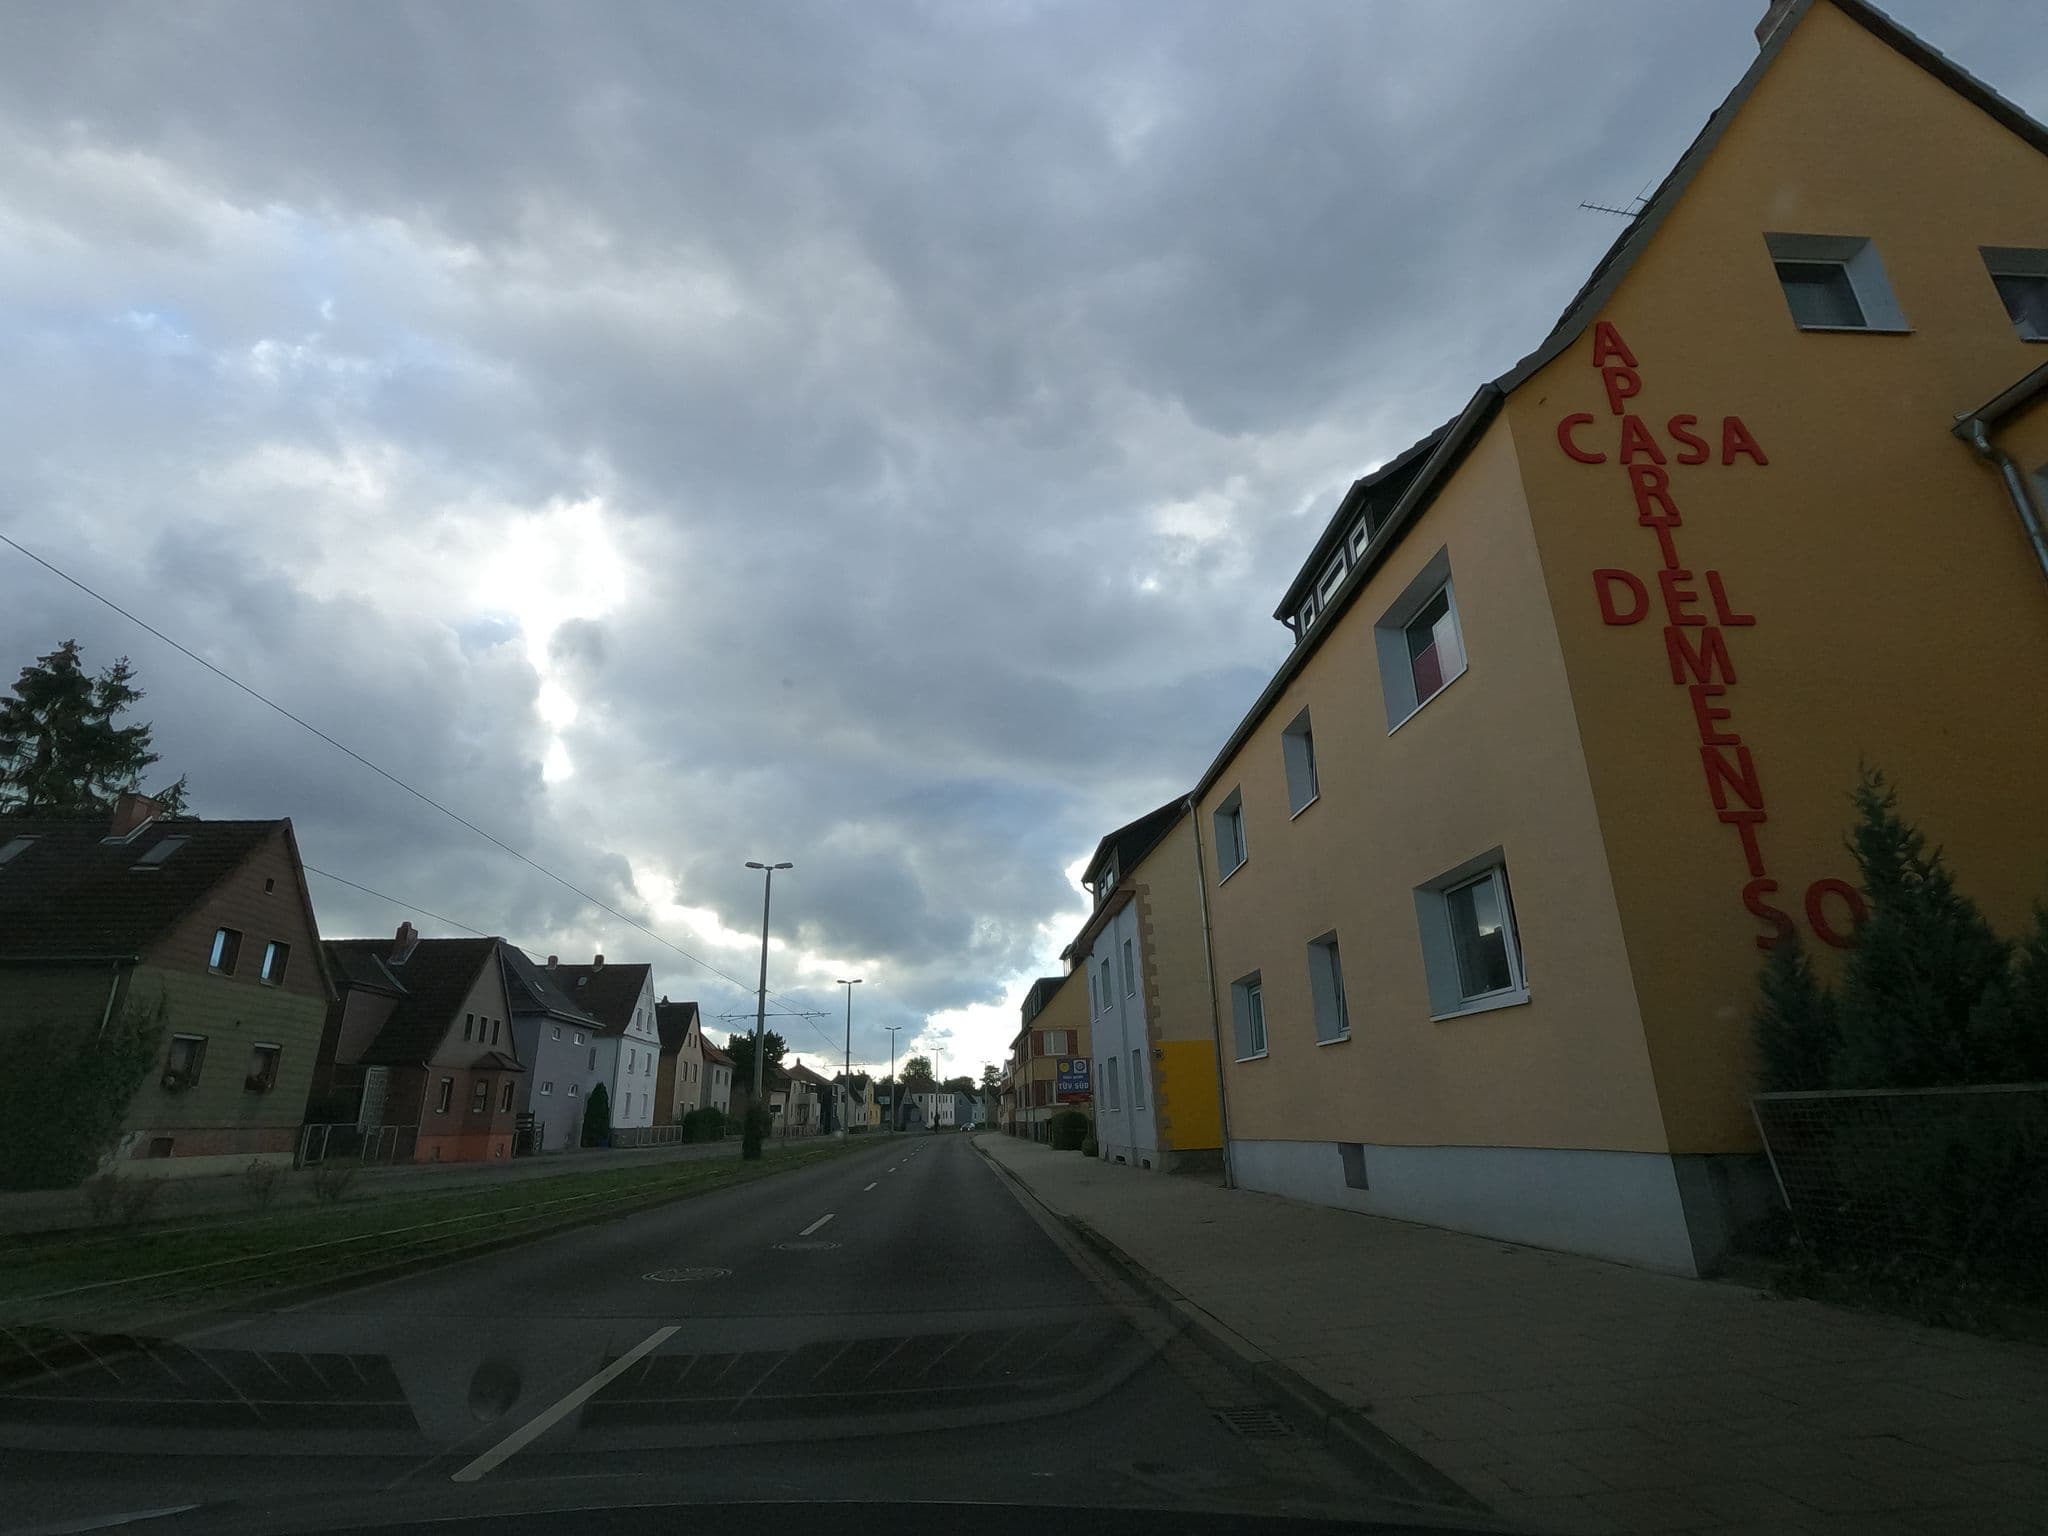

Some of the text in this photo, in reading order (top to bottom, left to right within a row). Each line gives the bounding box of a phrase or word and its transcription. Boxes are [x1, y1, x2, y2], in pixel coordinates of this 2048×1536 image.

[1557, 413, 1769, 466] CASA
[1592, 568, 1757, 626] DEL
[1592, 321, 1796, 950] APARTEMENTS
[1058, 1080, 1089, 1090] TÜV SÜD
